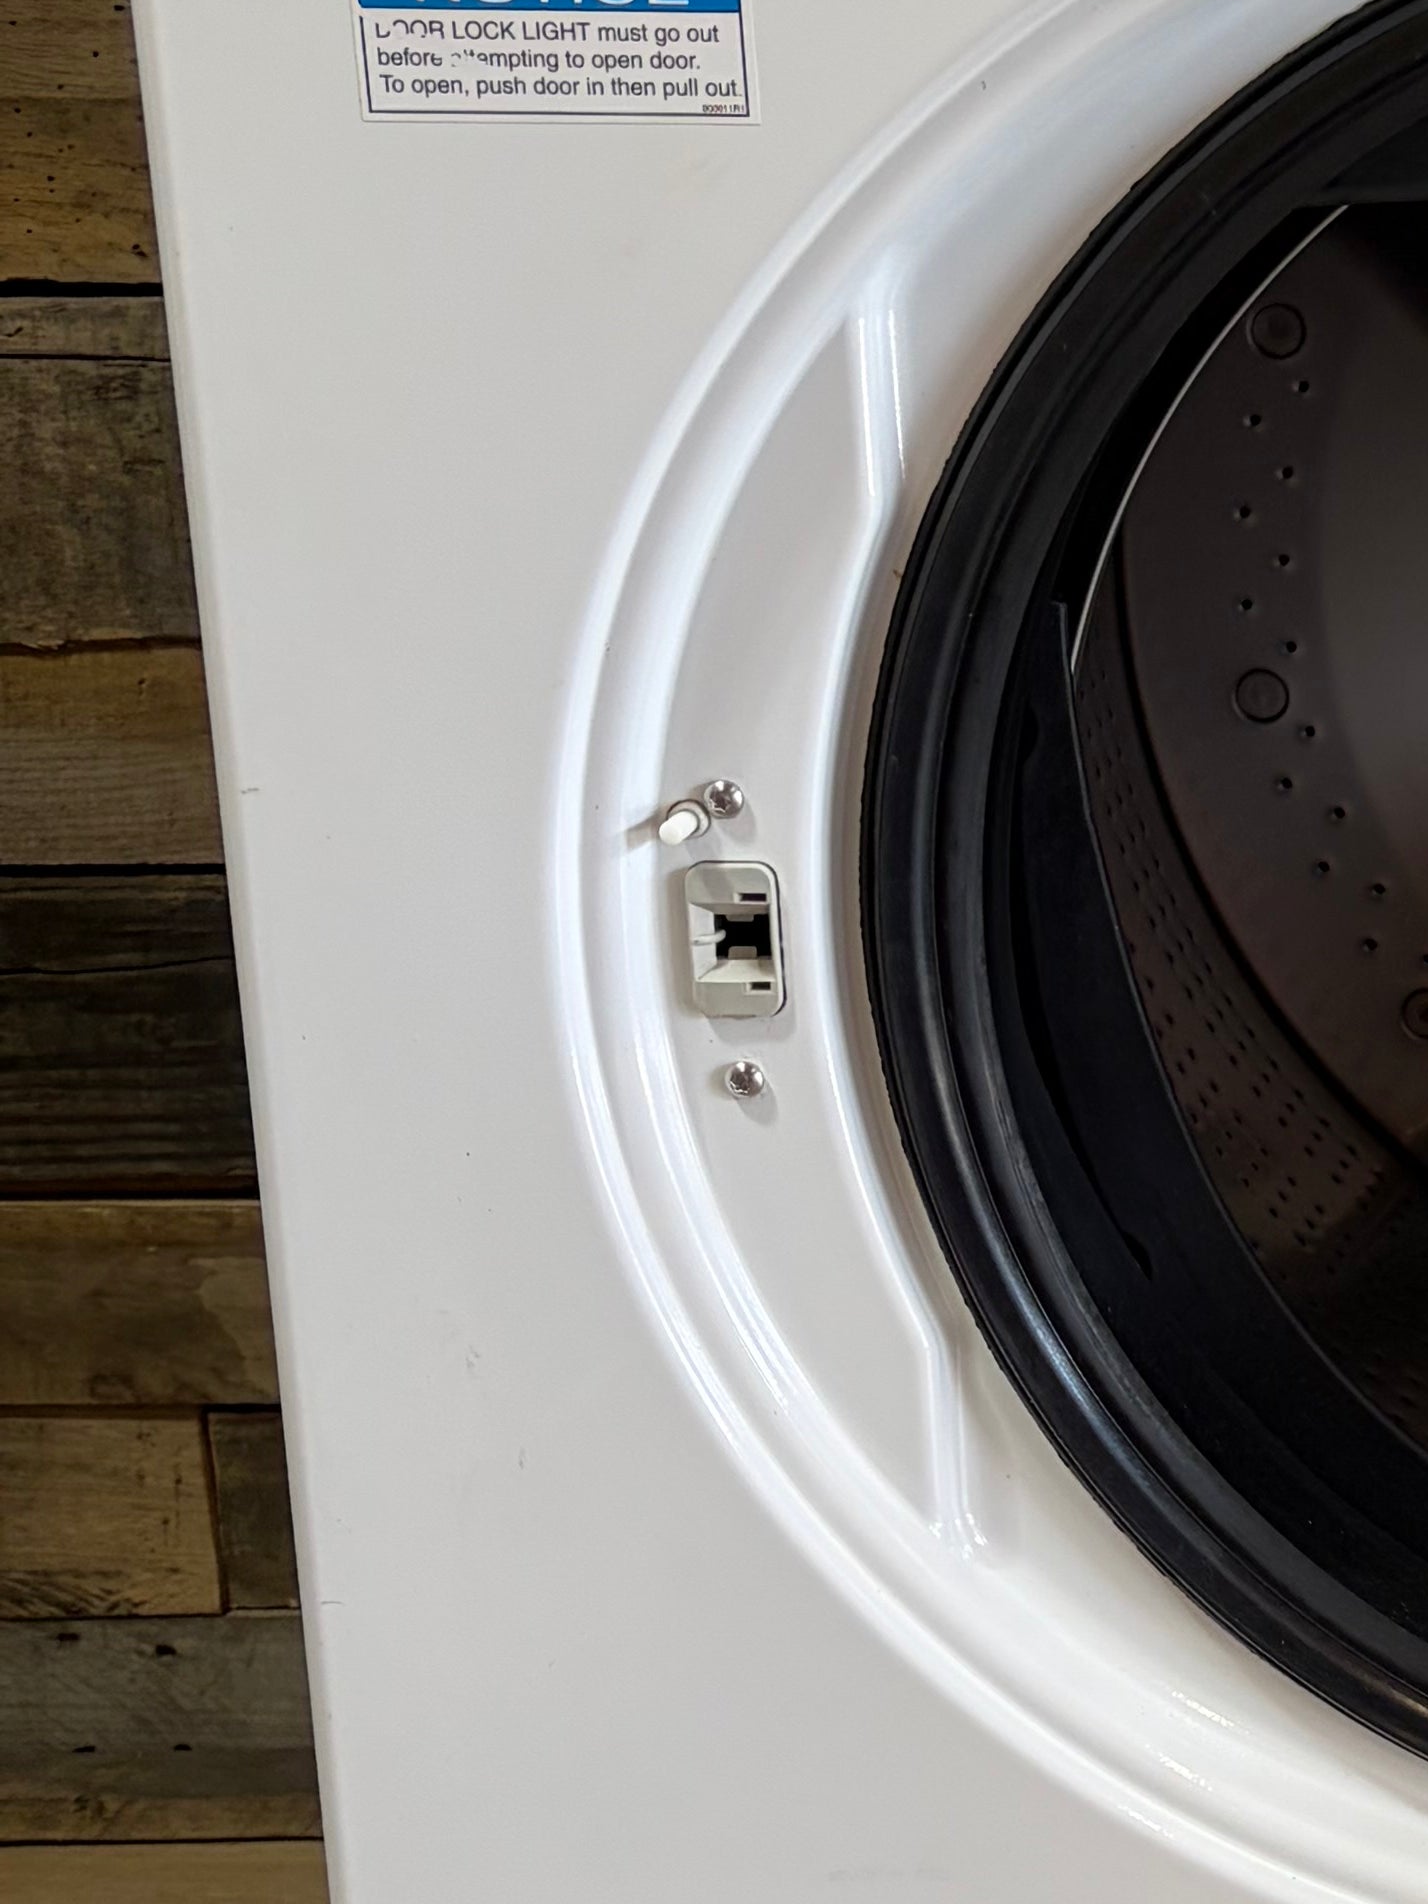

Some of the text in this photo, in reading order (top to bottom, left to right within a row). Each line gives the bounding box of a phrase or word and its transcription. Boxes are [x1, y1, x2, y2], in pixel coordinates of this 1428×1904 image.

[452, 21, 515, 40] LOCK
[522, 21, 590, 41] LIGHT
[598, 24, 648, 41] must
[655, 28, 680, 46] go
[687, 25, 719, 42] out
[377, 47, 442, 66] before
[565, 51, 584, 68] to
[592, 54, 642, 72] open
[650, 51, 700, 69] door.
[379, 74, 404, 93] To
[411, 79, 468, 98] open,
[477, 77, 526, 99] push
[534, 77, 580, 95] door
[587, 77, 604, 95] in
[611, 77, 655, 96] then
[663, 78, 698, 100] pull
